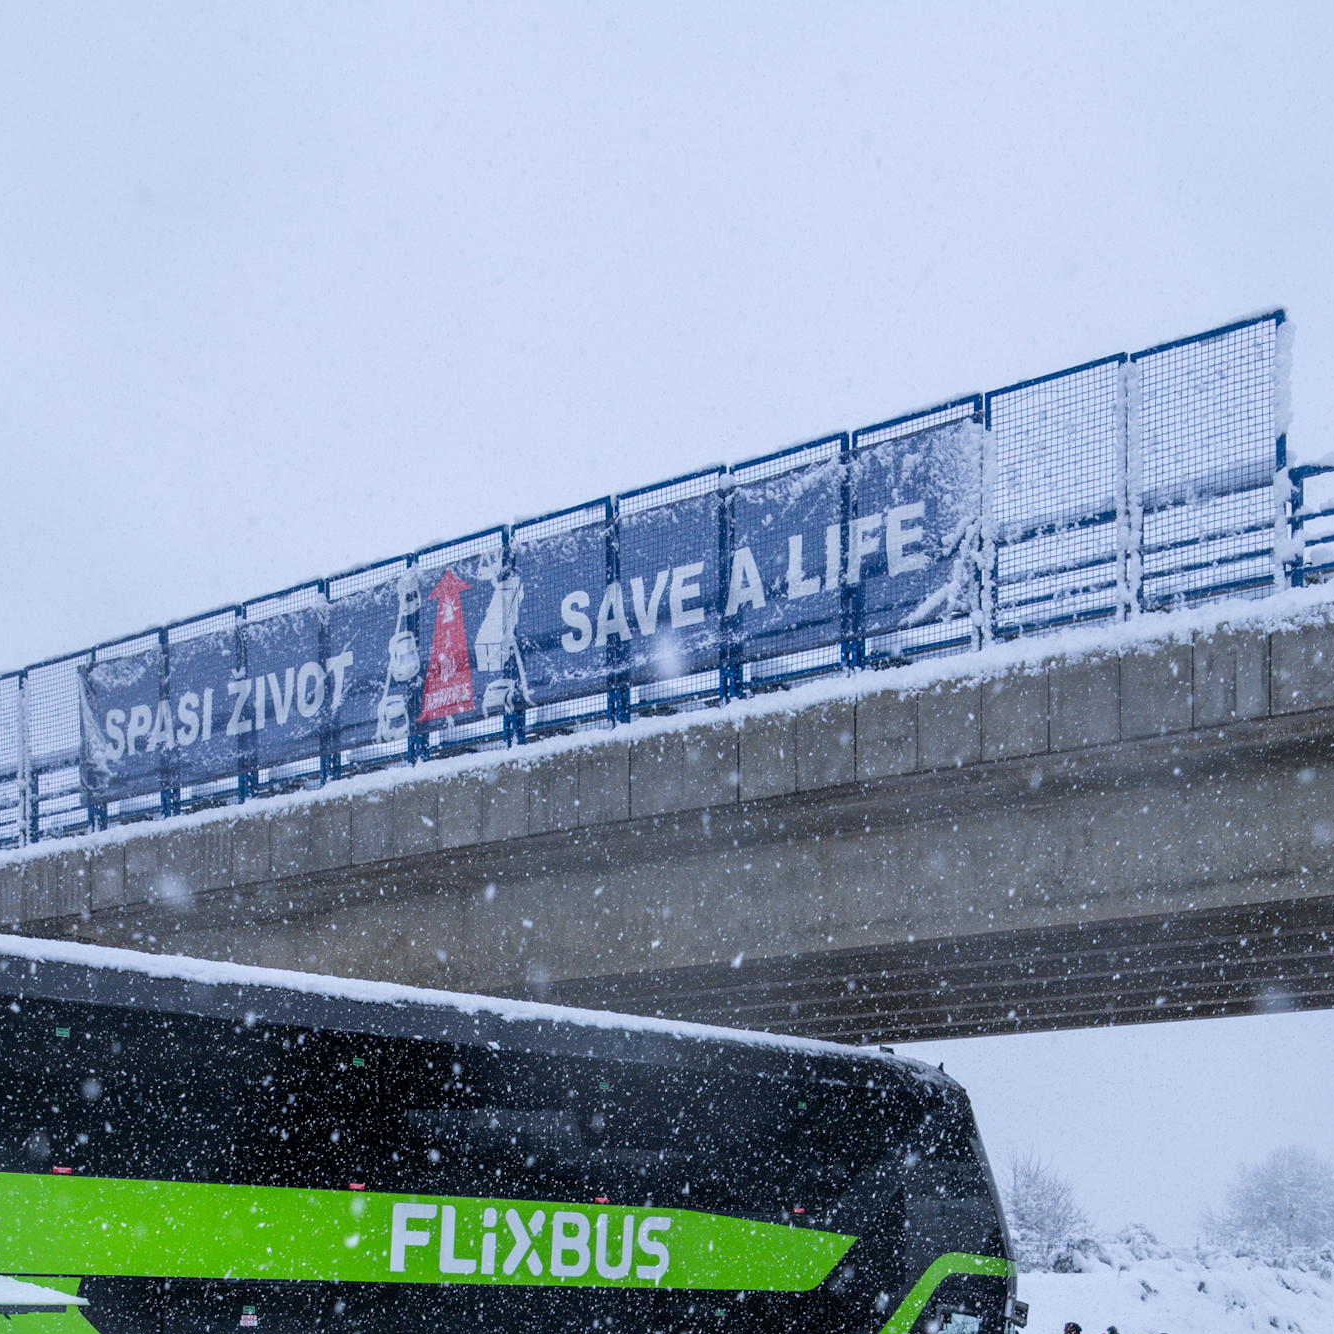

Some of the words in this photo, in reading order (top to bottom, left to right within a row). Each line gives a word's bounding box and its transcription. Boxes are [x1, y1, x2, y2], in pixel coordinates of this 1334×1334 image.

[560, 561, 705, 653] SAVE
[724, 546, 766, 617] A
[787, 502, 927, 600] LIFE
[105, 687, 214, 759] SPASI
[226, 651, 354, 736] ŽIVOT
